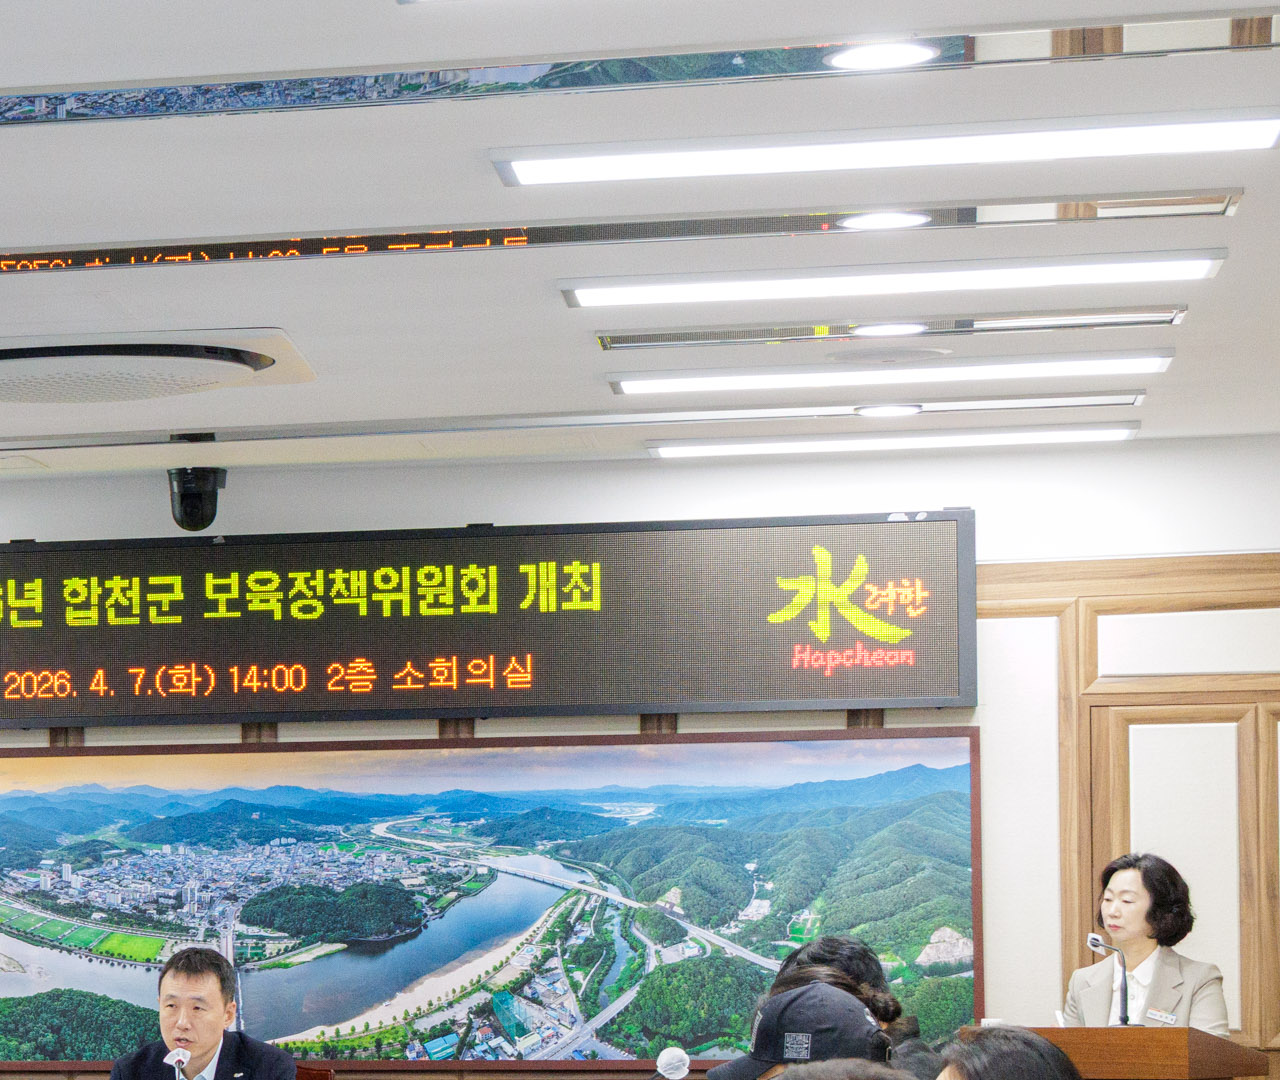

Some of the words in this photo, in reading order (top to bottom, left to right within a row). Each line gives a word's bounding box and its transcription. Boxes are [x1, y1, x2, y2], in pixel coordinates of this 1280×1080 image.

[63, 575, 184, 627] 합천군
[203, 564, 499, 621] 보육정책위원회
[519, 560, 602, 614] 개최
[3, 670, 78, 699] 2026.
[88, 668, 115, 697] 4.
[229, 663, 308, 694] 14:00
[326, 657, 378, 693] 2층
[391, 653, 533, 690] 소회의실
[791, 640, 916, 677] Hapcheon
